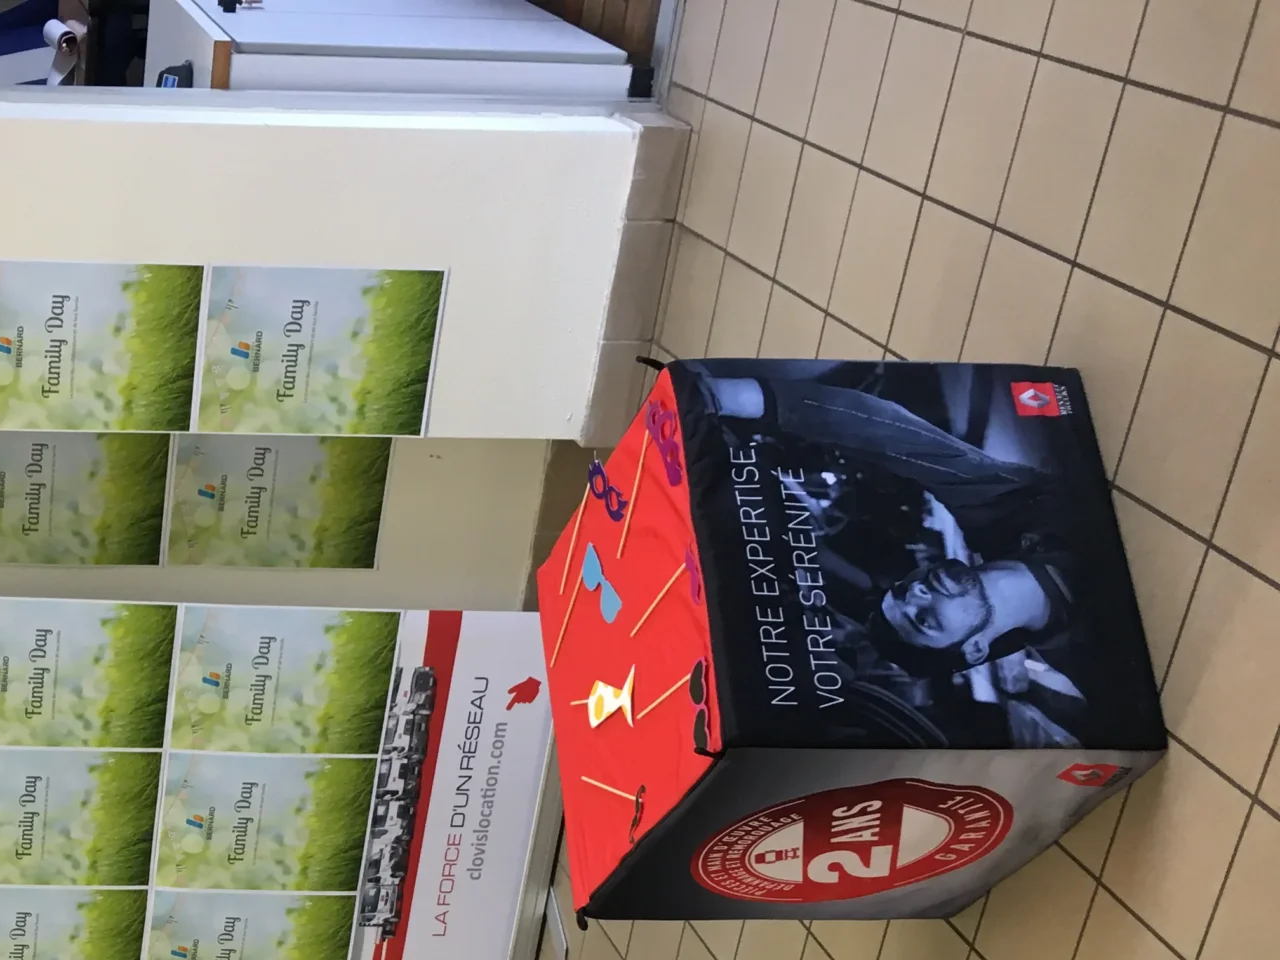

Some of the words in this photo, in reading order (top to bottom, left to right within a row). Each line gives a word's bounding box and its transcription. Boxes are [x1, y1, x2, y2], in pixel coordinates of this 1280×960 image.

[45, 295, 70, 333] Day
[284, 300, 310, 338] Day
[15, 326, 25, 368] BERNARD
[252, 330, 264, 373] BERNARD
[41, 339, 68, 398] Family
[276, 344, 305, 402] Family
[25, 443, 49, 478] Day
[247, 447, 272, 481] Day
[22, 483, 46, 536] Family
[217, 474, 228, 512] BERNARD
[240, 486, 267, 539] Family
[729, 442, 779, 596] EXPERTISE,
[772, 466, 826, 606] SÉRÉNITÉ
[29, 629, 53, 663] Day
[252, 637, 277, 670] Day
[756, 606, 798, 705] NOTRE
[804, 615, 844, 709] VOTRE
[0, 656, 10, 692] BERNARD
[25, 667, 50, 719] Family
[221, 663, 232, 699] BERNARD
[245, 675, 272, 725] Family
[458, 676, 489, 770] RÉSEAU
[19, 776, 42, 807] Day
[234, 782, 259, 813] Day
[449, 775, 473, 827] D'UN
[466, 722, 508, 881] clovislocation.com
[15, 812, 40, 860] Family
[205, 806, 215, 841] BERNARD
[227, 817, 254, 865] Family
[727, 813, 802, 859] REMORQUAGE
[830, 799, 883, 842] ANS
[933, 794, 992, 861] GARANTIE
[437, 833, 462, 906] FORCE
[707, 853, 723, 871] MAIN
[714, 872, 726, 880] ET
[726, 860, 741, 868] ET
[807, 844, 893, 884] 2
[10, 912, 32, 940] Day
[217, 917, 241, 945] Day
[431, 910, 450, 936] LA
